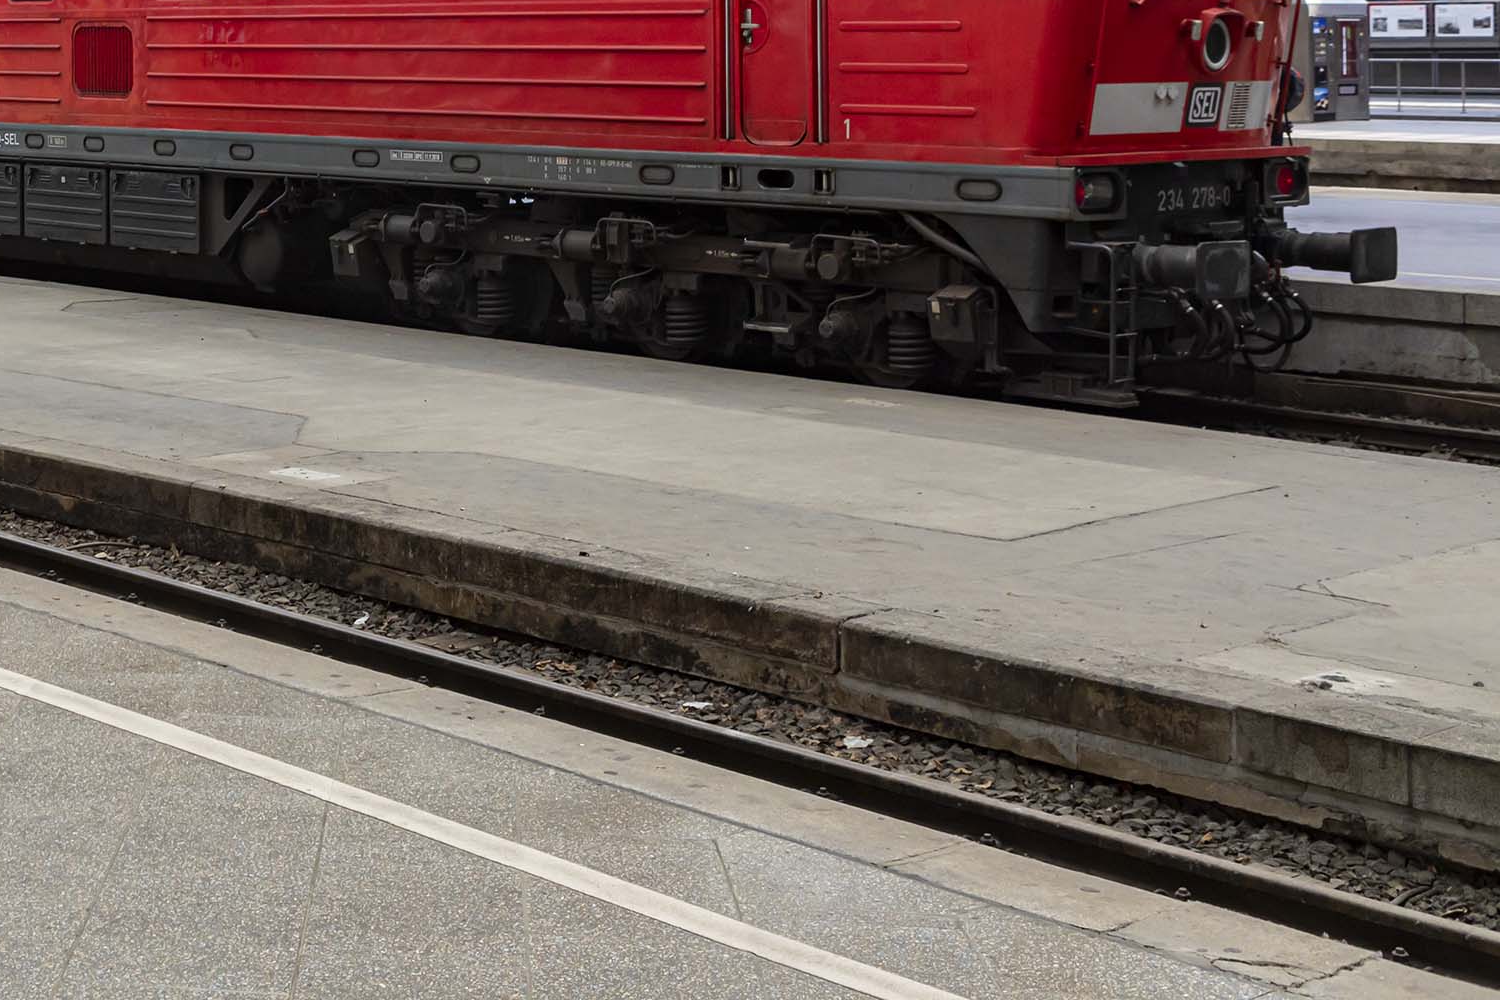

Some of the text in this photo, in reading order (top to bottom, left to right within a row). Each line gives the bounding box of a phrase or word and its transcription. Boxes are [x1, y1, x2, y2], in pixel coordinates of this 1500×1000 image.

[1192, 91, 1217, 119] SEL
[843, 118, 851, 140] 1
[1157, 184, 1232, 212] 234 278-0
